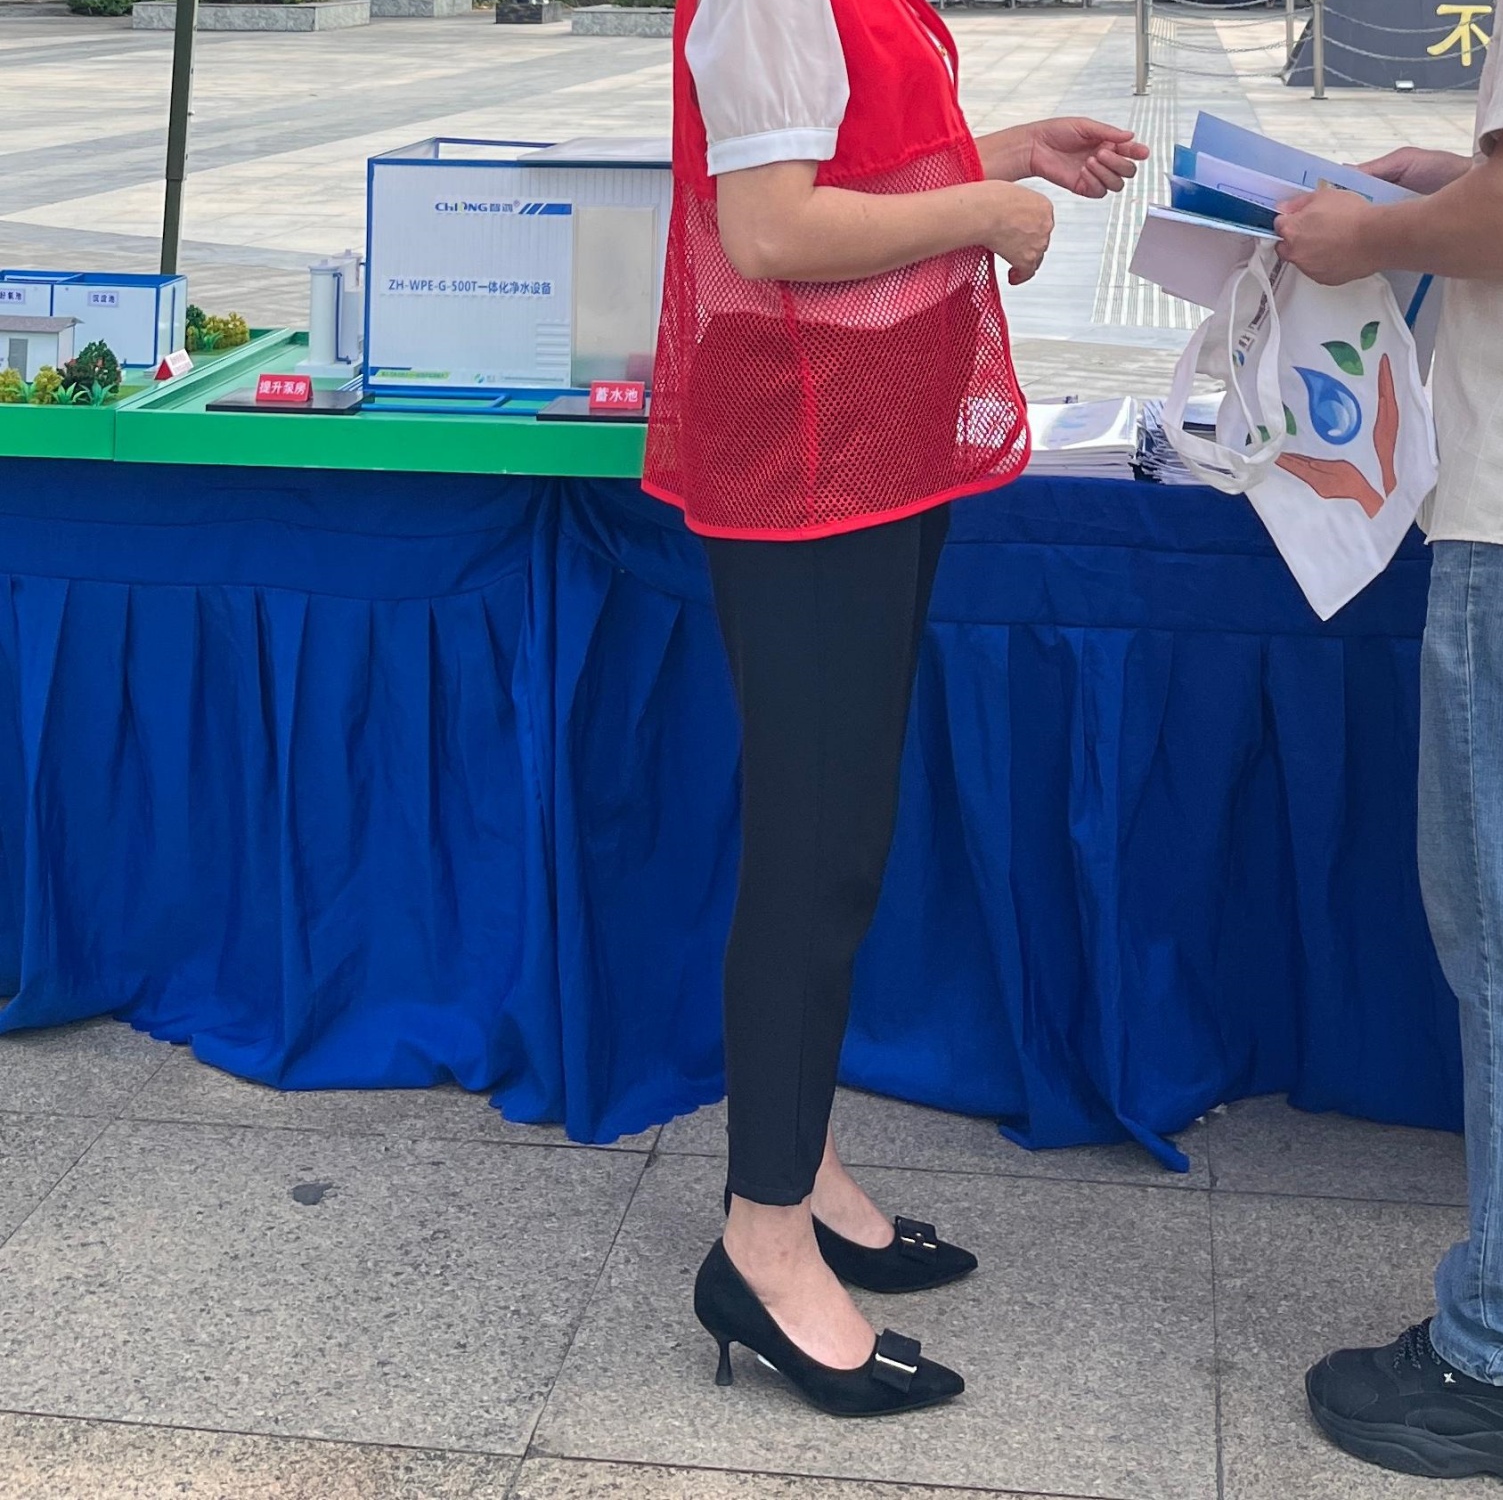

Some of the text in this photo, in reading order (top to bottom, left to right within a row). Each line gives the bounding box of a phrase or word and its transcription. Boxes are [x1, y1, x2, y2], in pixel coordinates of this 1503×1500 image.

[258, 379, 307, 396] 提升泵房
[595, 386, 639, 403] 蓄水池
